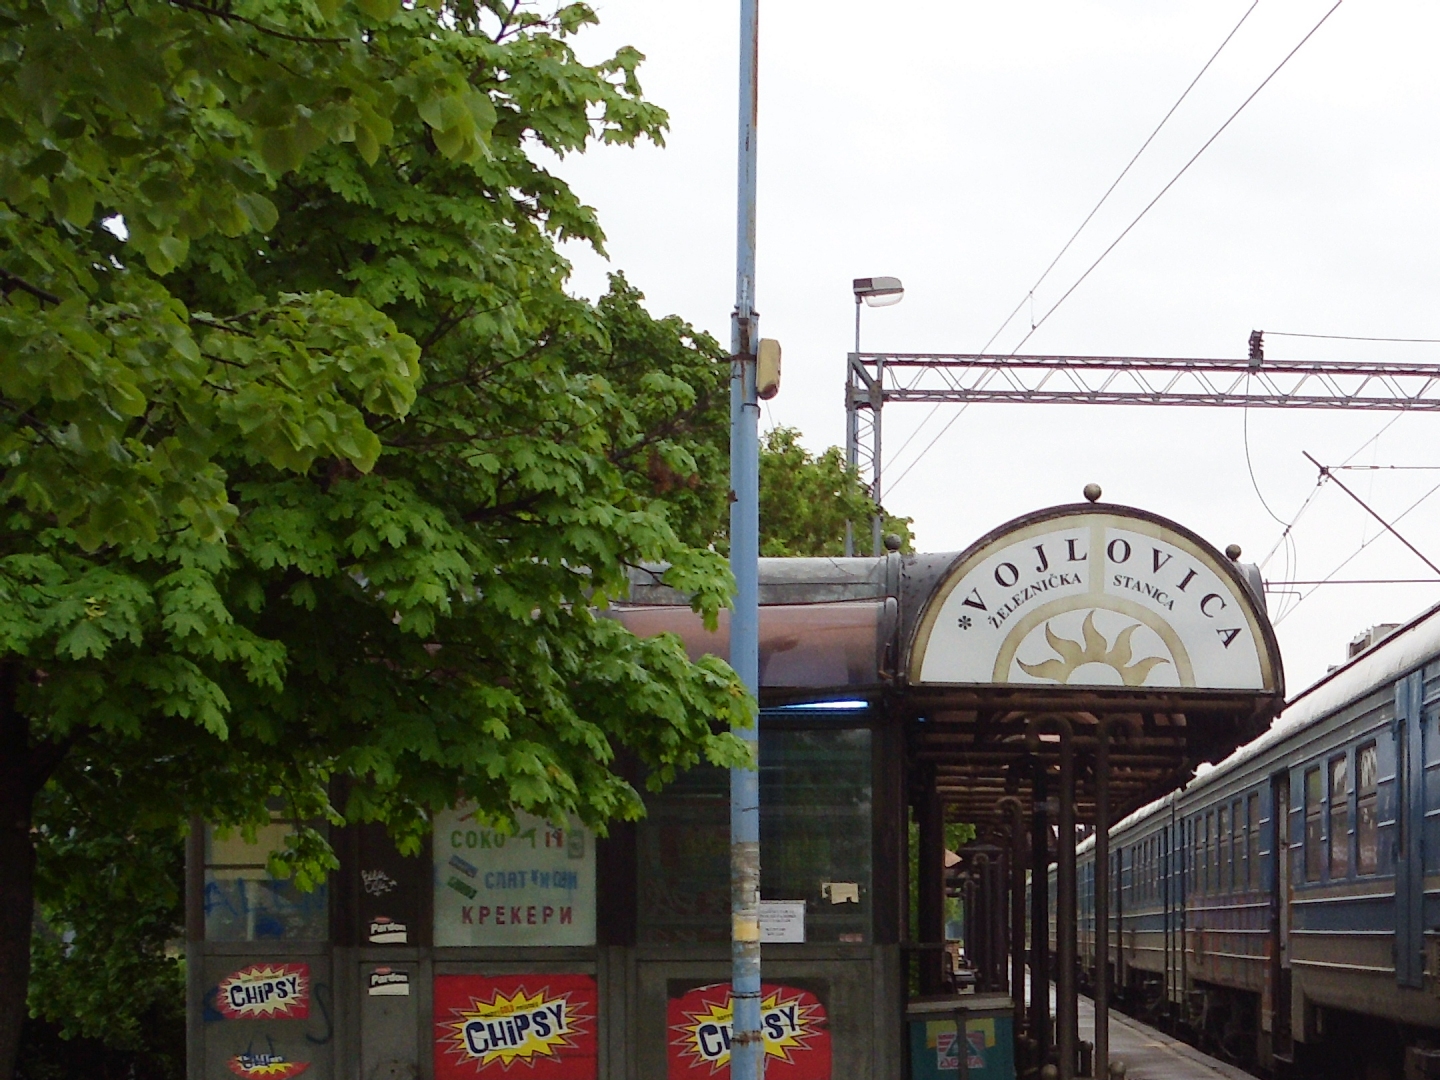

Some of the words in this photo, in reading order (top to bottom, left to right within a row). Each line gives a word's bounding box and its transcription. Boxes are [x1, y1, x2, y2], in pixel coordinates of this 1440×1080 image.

[961, 538, 1243, 650] VOJLOVICA
[987, 572, 1083, 630] ŽELEZNIČKA
[1112, 574, 1175, 612] STANICA
[462, 905, 573, 925] КРЕКЕРИ
[370, 922, 407, 935] Pardon
[371, 973, 408, 986] Pardon
